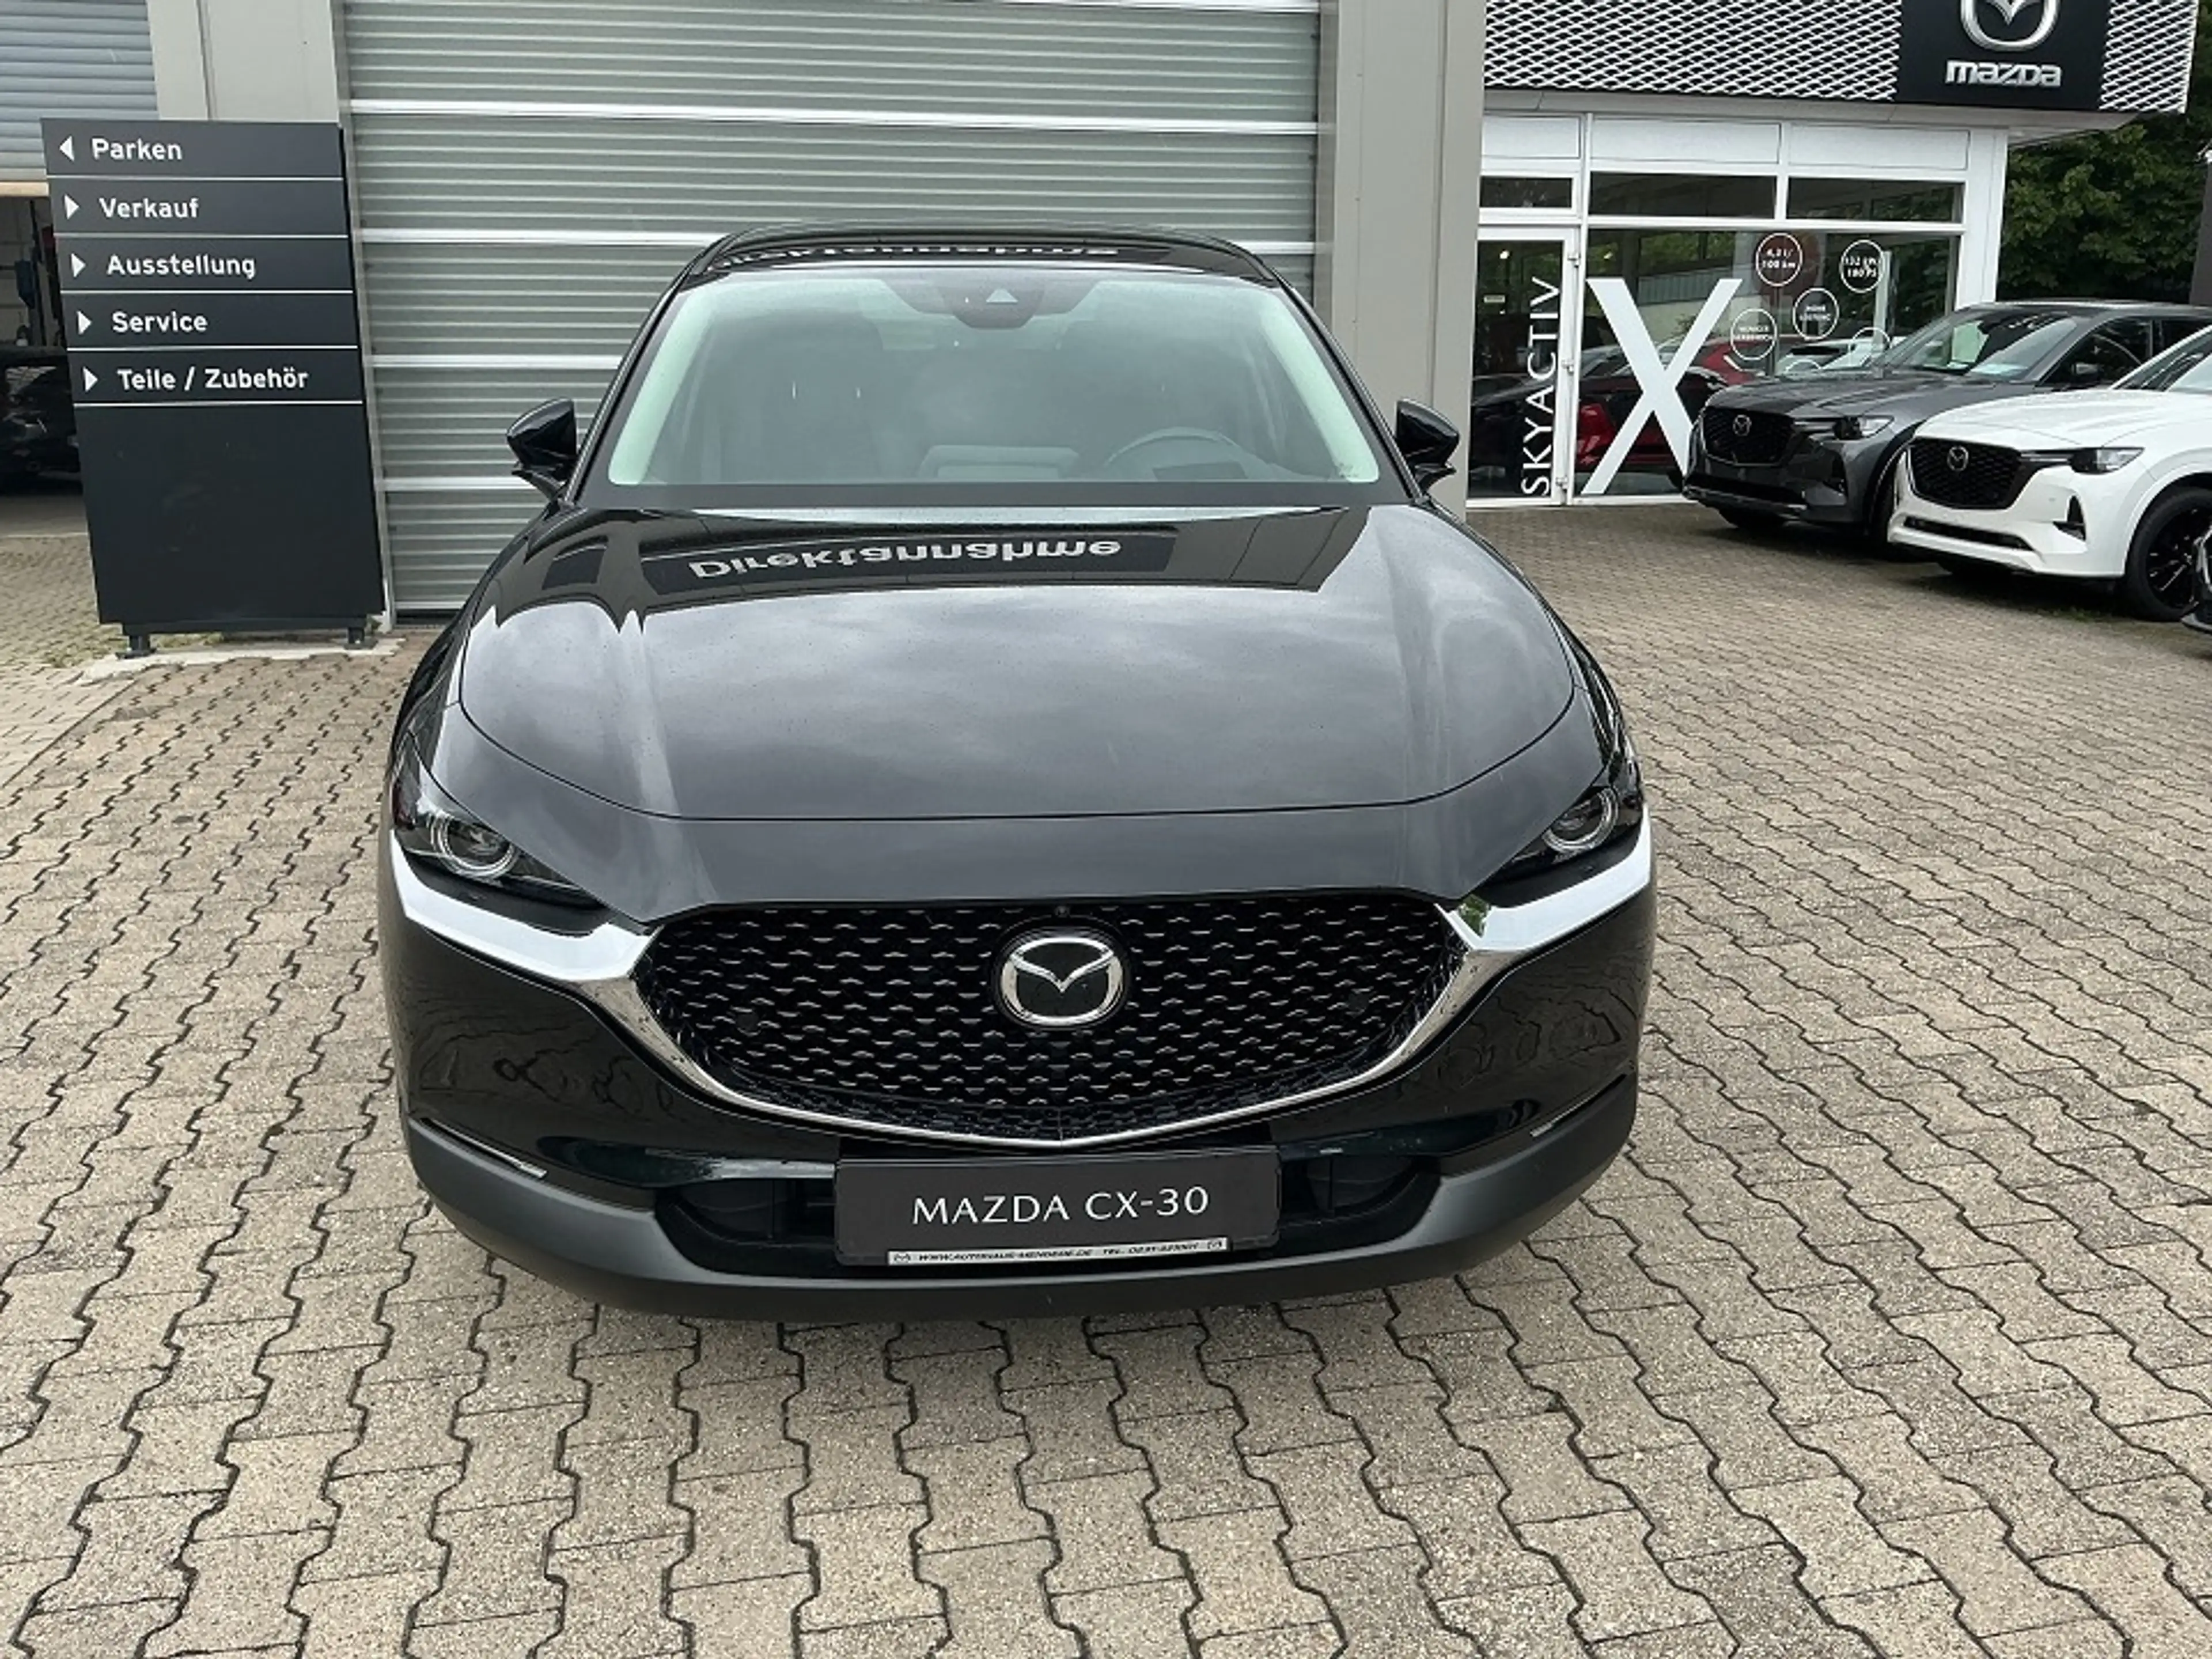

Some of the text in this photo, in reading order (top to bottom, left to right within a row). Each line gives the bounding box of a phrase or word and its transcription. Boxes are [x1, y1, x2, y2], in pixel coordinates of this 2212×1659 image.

[1945, 60, 2062, 86] mazda
[92, 138, 183, 160] Parken
[99, 197, 199, 218] Verkauf
[107, 253, 256, 280] Ausstellung
[112, 310, 208, 332] Service
[117, 366, 308, 391] Teile / Zubehör
[1521, 276, 1743, 496] SKYACTIV X
[912, 1186, 1209, 1225] MAZDA CX-30
